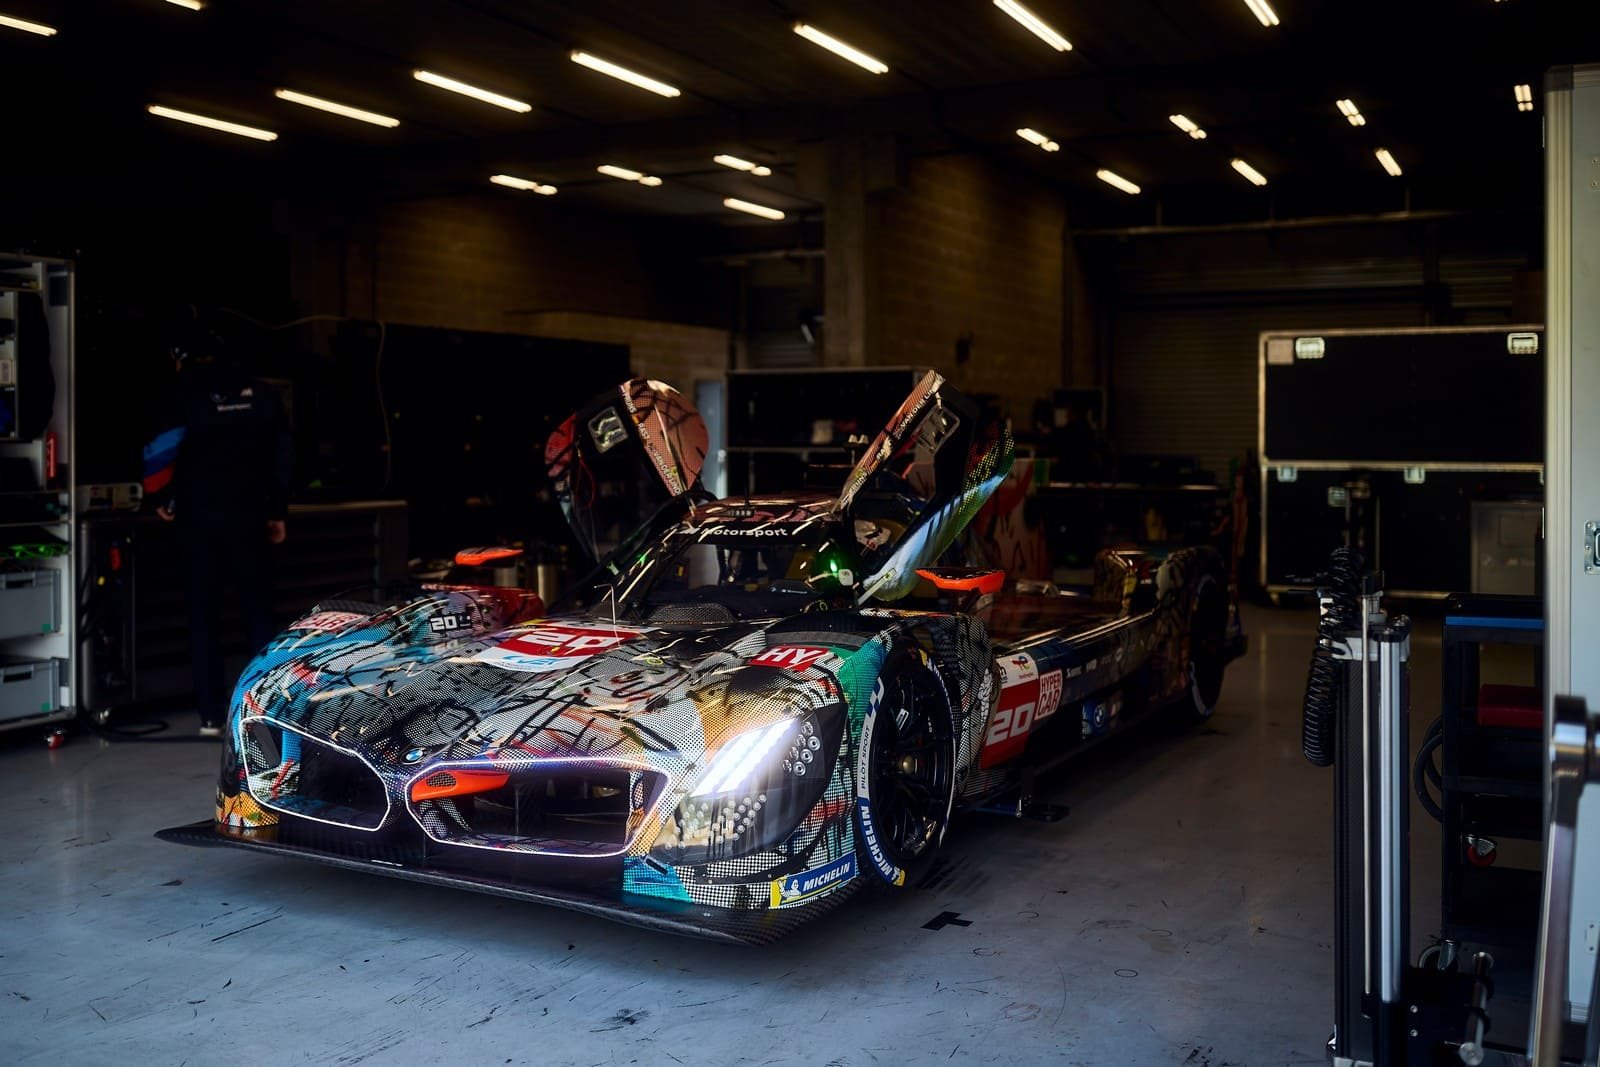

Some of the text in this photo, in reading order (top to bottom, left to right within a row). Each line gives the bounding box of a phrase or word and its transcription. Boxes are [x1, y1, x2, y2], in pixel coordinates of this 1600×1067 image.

[1038, 689, 1060, 716] CAR
[985, 701, 1036, 747] 20
[862, 725, 870, 758] SPORT
[861, 806, 893, 876] MICHELIN
[803, 862, 851, 891] MICHELIN
